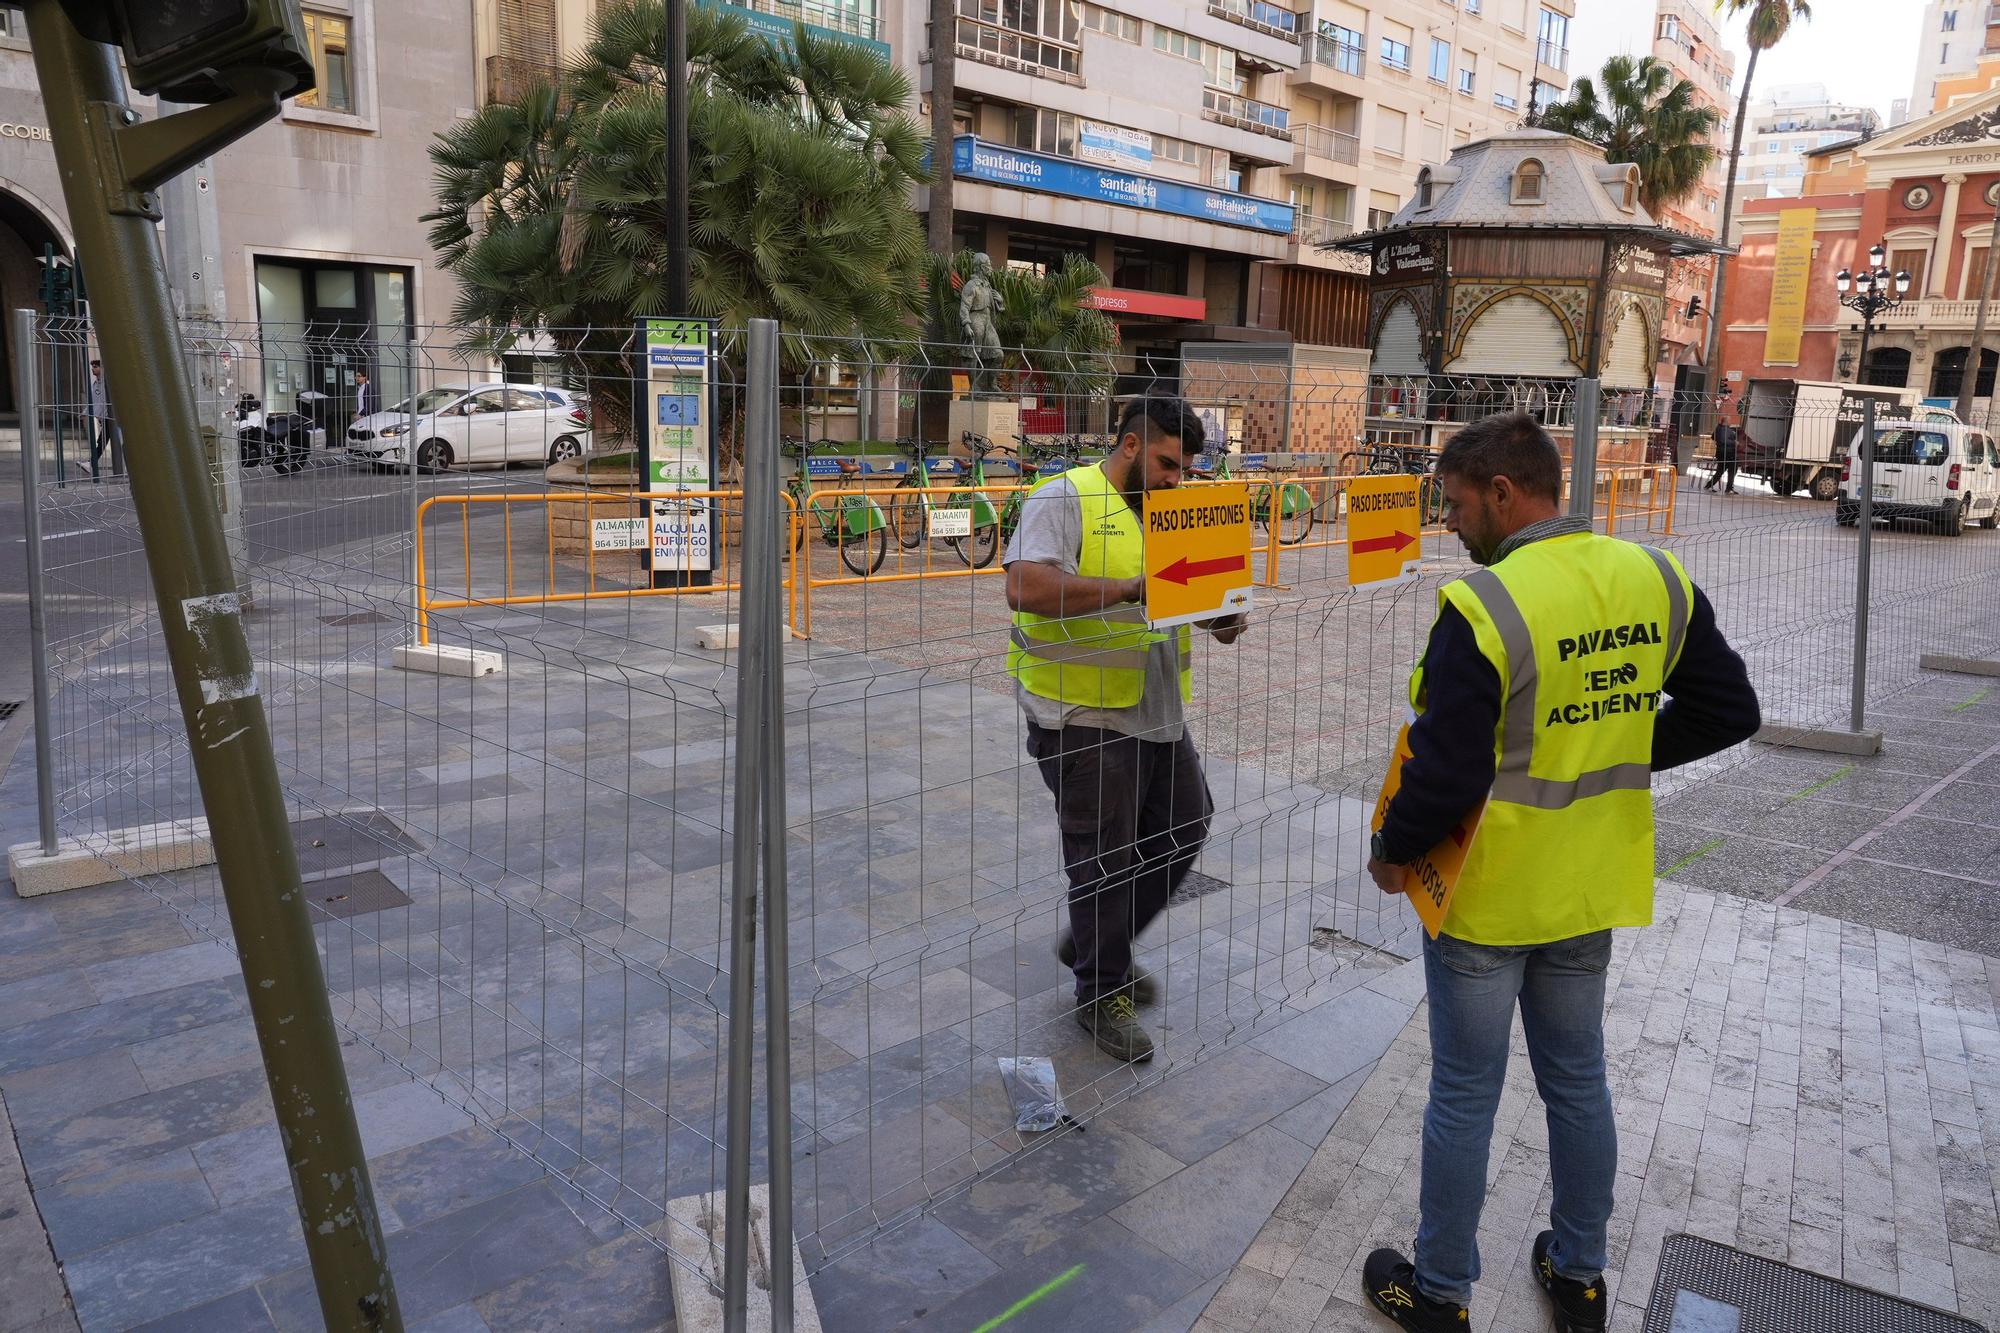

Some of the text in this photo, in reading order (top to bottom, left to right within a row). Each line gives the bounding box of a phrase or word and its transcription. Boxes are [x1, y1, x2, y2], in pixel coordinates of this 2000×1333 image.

[747, 18, 791, 34] Ballester
[1092, 123, 1118, 135] NUEVO
[1121, 128, 1149, 142] HOGAR
[975, 152, 1042, 176] santalucía
[1947, 153, 1991, 164] TEATRO
[1100, 177, 1156, 198] santalucía
[1391, 242, 1420, 256] L'Antiga
[1396, 254, 1434, 270] Valenciana
[1634, 260, 1664, 278] Valenciana
[671, 323, 702, 343] 41
[1351, 494, 1370, 513] PASO
[1372, 493, 1381, 511] DE
[1382, 491, 1416, 509] PEATONES
[1150, 504, 1244, 532] PASO DE PEATONES
[654, 523, 707, 535] ALQULA
[595, 540, 611, 548] 964
[613, 539, 627, 547] 591
[1557, 622, 1661, 662] PAVASAL
[1546, 690, 1661, 727] ACCIENT
[1423, 863, 1447, 909] PASO
